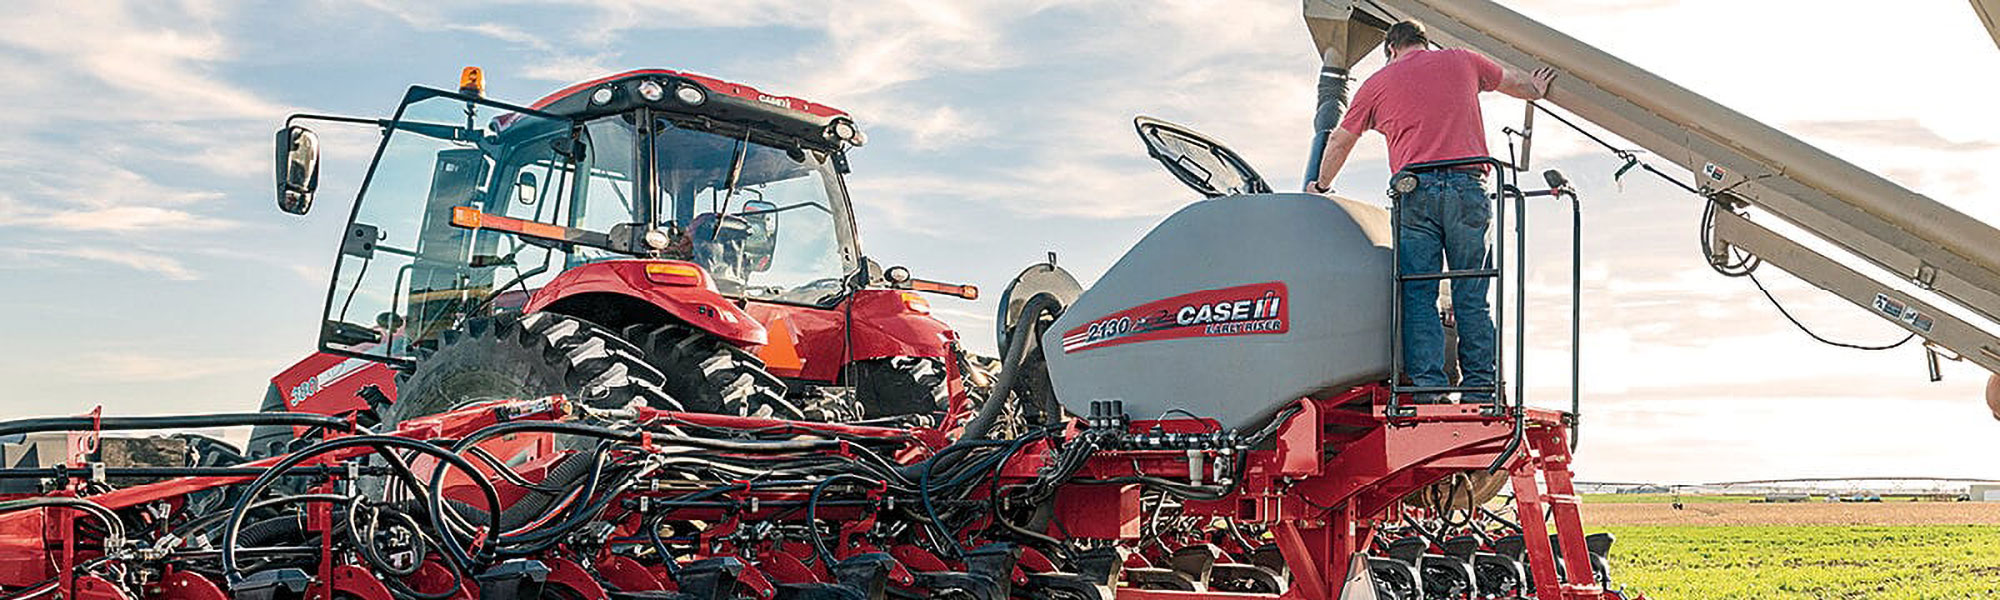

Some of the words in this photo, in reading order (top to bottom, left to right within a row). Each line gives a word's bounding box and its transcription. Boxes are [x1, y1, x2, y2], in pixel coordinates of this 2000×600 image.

[1176, 299, 1251, 326] CASE
[1086, 316, 1131, 342] 2130
[1205, 321, 1242, 335] EARLY
[1243, 319, 1282, 332] RISER
[290, 376, 320, 407] 380
